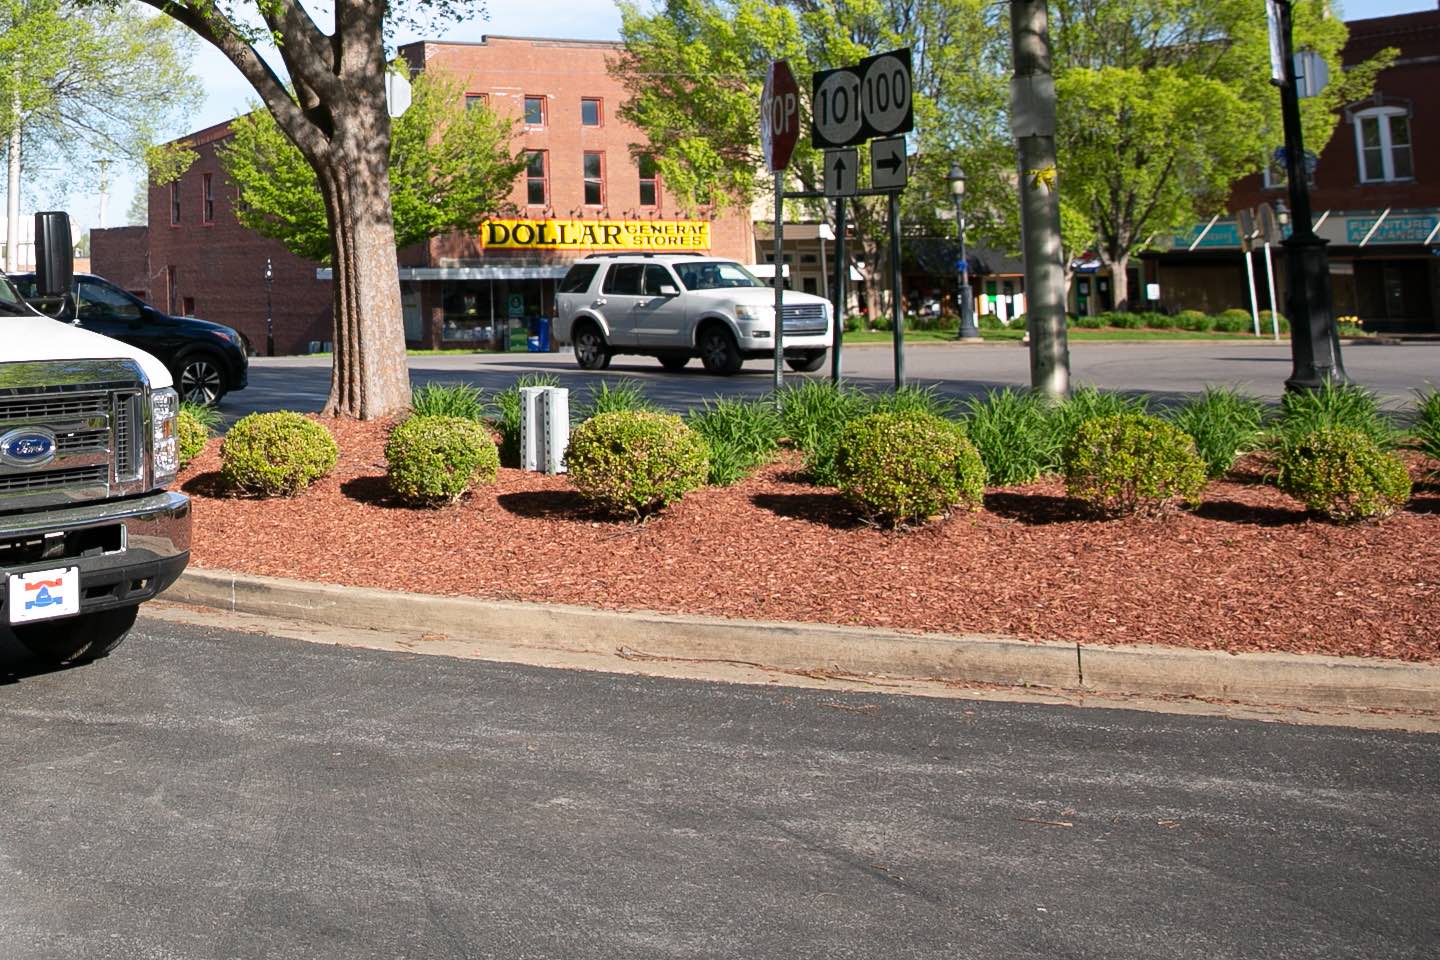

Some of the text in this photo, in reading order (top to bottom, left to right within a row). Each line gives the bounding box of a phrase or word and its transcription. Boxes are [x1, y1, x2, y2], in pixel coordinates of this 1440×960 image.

[820, 83, 859, 126] 101
[867, 69, 906, 114] 100
[762, 93, 796, 137] STOP
[487, 223, 708, 245] DOLLAR GENERAL
[632, 235, 702, 246] STORES
[16, 439, 44, 455] Ford
